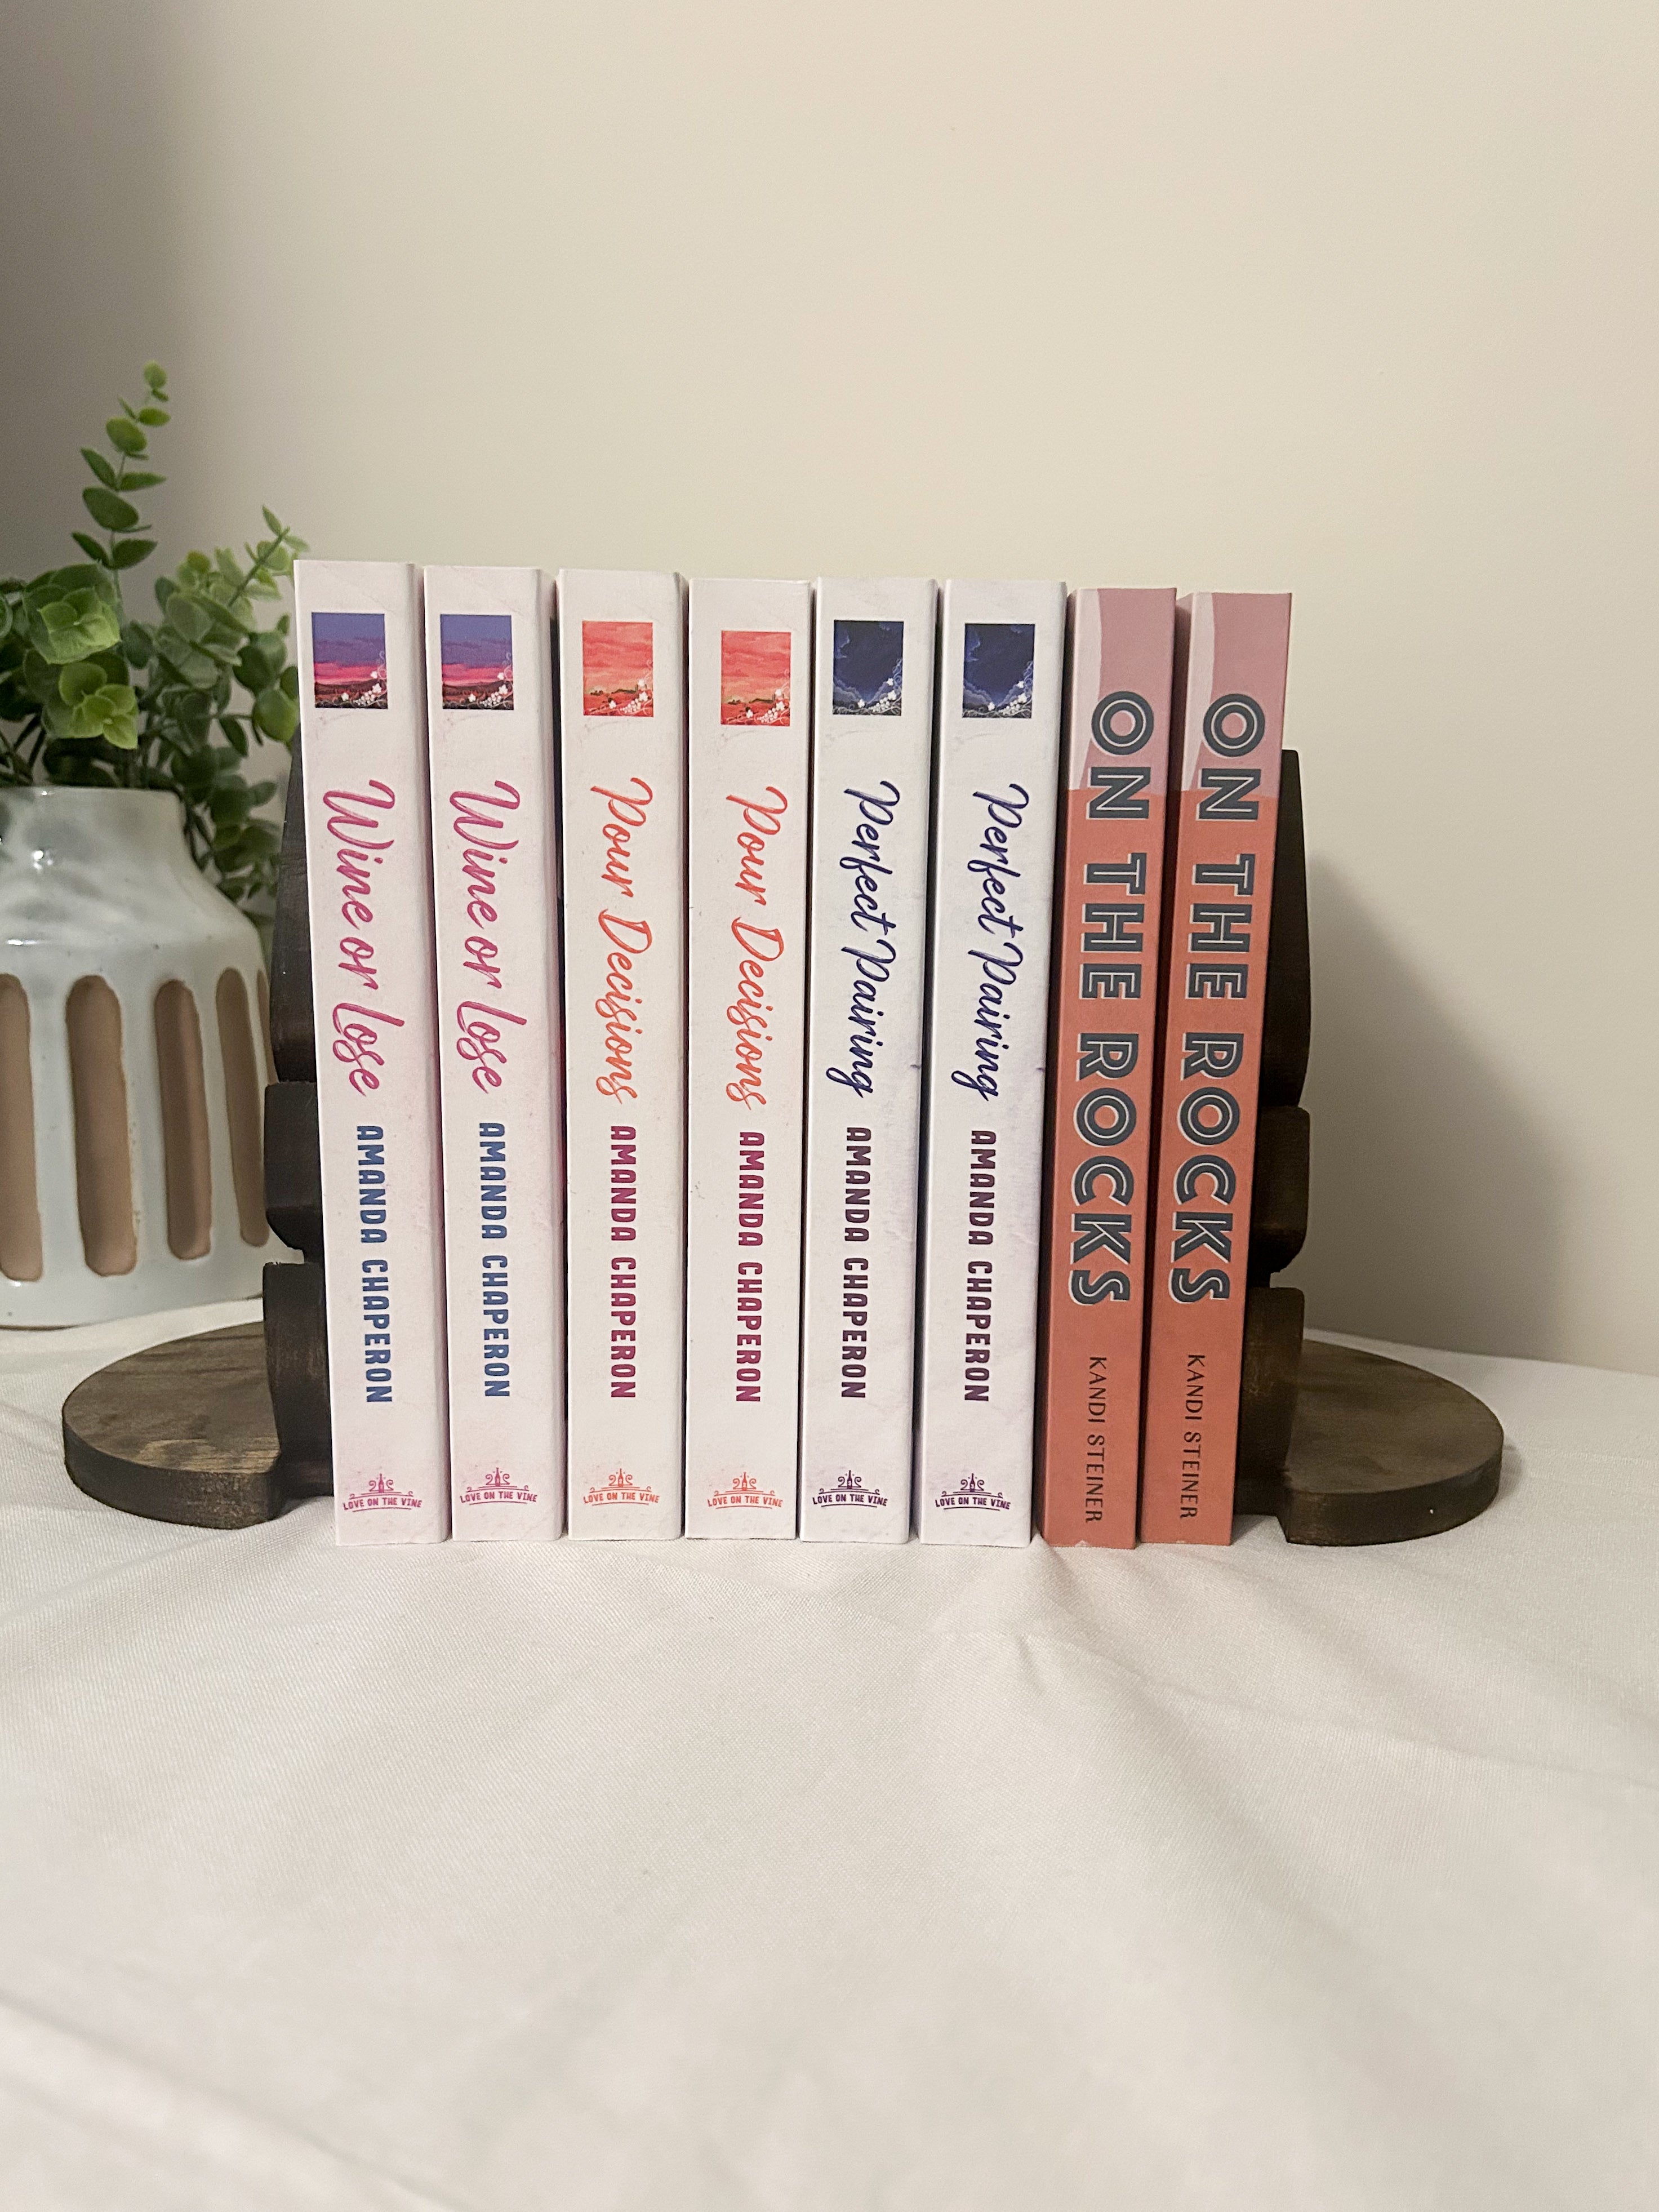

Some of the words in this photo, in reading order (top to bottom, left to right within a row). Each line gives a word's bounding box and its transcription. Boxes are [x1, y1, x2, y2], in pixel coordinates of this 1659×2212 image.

[1087, 691, 1154, 820] ON
[1198, 693, 1266, 820] ON
[323, 779, 395, 929] Wine
[450, 780, 520, 928] Wine
[590, 776, 653, 897] Pour
[726, 786, 788, 906] Pour
[840, 780, 901, 938] Perfect
[967, 783, 1029, 938] Perfect
[339, 936, 379, 990] or
[462, 935, 501, 989] or
[1080, 852, 1147, 1000] THE
[1185, 853, 1256, 1000] THE
[332, 1001, 404, 1096] Lose
[457, 1000, 527, 1094] Lose
[594, 909, 653, 1104] Decisions
[726, 917, 784, 1111] Decisions
[826, 939, 896, 1099] Pairing
[951, 942, 1024, 1101] Pairing
[357, 1125, 387, 1243] AMANDA
[479, 1123, 508, 1239] AMANDA
[611, 1126, 637, 1241] AMANDA
[737, 1132, 765, 1246] AMANDA
[844, 1127, 872, 1242] AMANDA
[968, 1130, 997, 1245] AMANDA
[1068, 1033, 1140, 1305] ROCKS
[1169, 1032, 1243, 1304] ROCKS
[362, 1259, 393, 1402] CHAPERON
[482, 1255, 510, 1397] CHAPERON
[611, 1258, 637, 1398] CHAPERON
[736, 1263, 763, 1402] CHAPERON
[841, 1258, 869, 1398] CHAPERON
[964, 1262, 993, 1401] CHAPERON
[1088, 1356, 1108, 1423] KANDI
[1185, 1354, 1206, 1423] KANDI
[343, 1499, 364, 1510] LOVE
[401, 1498, 422, 1508] VINE
[460, 1493, 481, 1503] LOVE
[517, 1492, 537, 1502] VINE
[583, 1494, 603, 1503] LOVE
[640, 1493, 660, 1503] VINE
[708, 1496, 727, 1507] LOVE
[763, 1496, 783, 1507] VINE
[812, 1495, 833, 1504] LOVE
[868, 1495, 888, 1507] VINE
[935, 1498, 955, 1507] LOVE
[972, 1497, 987, 1505] THE
[991, 1499, 1011, 1509] VINE
[1085, 1434, 1106, 1523] STEINER
[1179, 1432, 1202, 1519] STEINER
